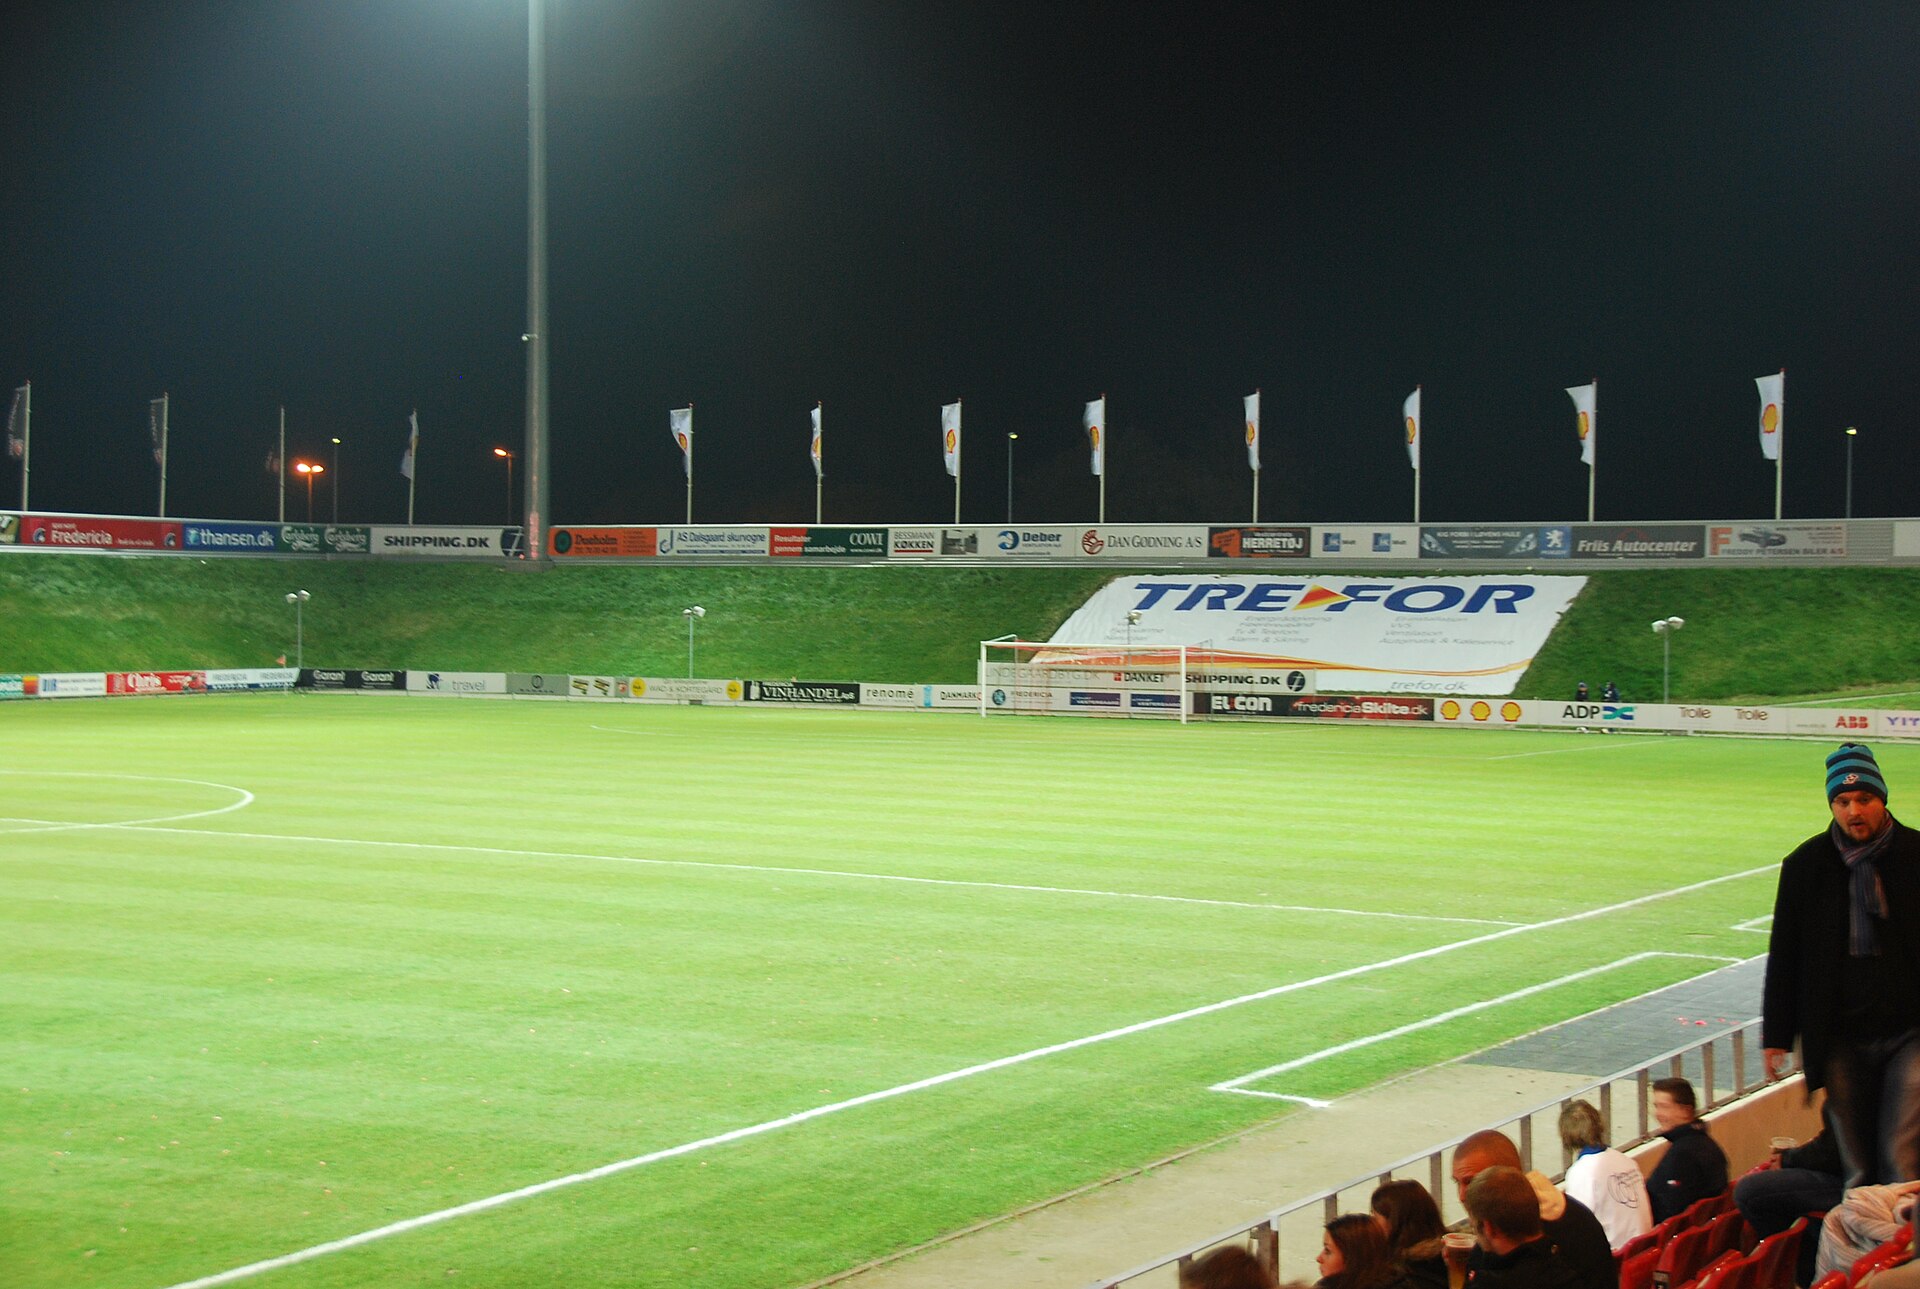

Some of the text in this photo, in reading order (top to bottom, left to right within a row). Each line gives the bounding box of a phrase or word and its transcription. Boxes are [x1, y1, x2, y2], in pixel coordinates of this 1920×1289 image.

[51, 529, 113, 545] Fredericia
[200, 528, 275, 547] thansen.dk
[384, 535, 490, 549] SHIPPING.DK
[849, 532, 884, 546] COWI
[1022, 531, 1063, 543] Deber
[894, 541, 934, 550] KØKKEN
[1577, 540, 1697, 552] Friis Autocenter
[313, 670, 346, 681] Garant
[360, 671, 395, 682] Garant
[1185, 674, 1281, 685] SHIPPING.DK
[1390, 680, 1468, 692] trefor.dk
[762, 686, 842, 699] VINHANDEL
[1562, 704, 1601, 719] ADP
[1835, 716, 1869, 729] ABB
[1886, 716, 1920, 727] YIT
